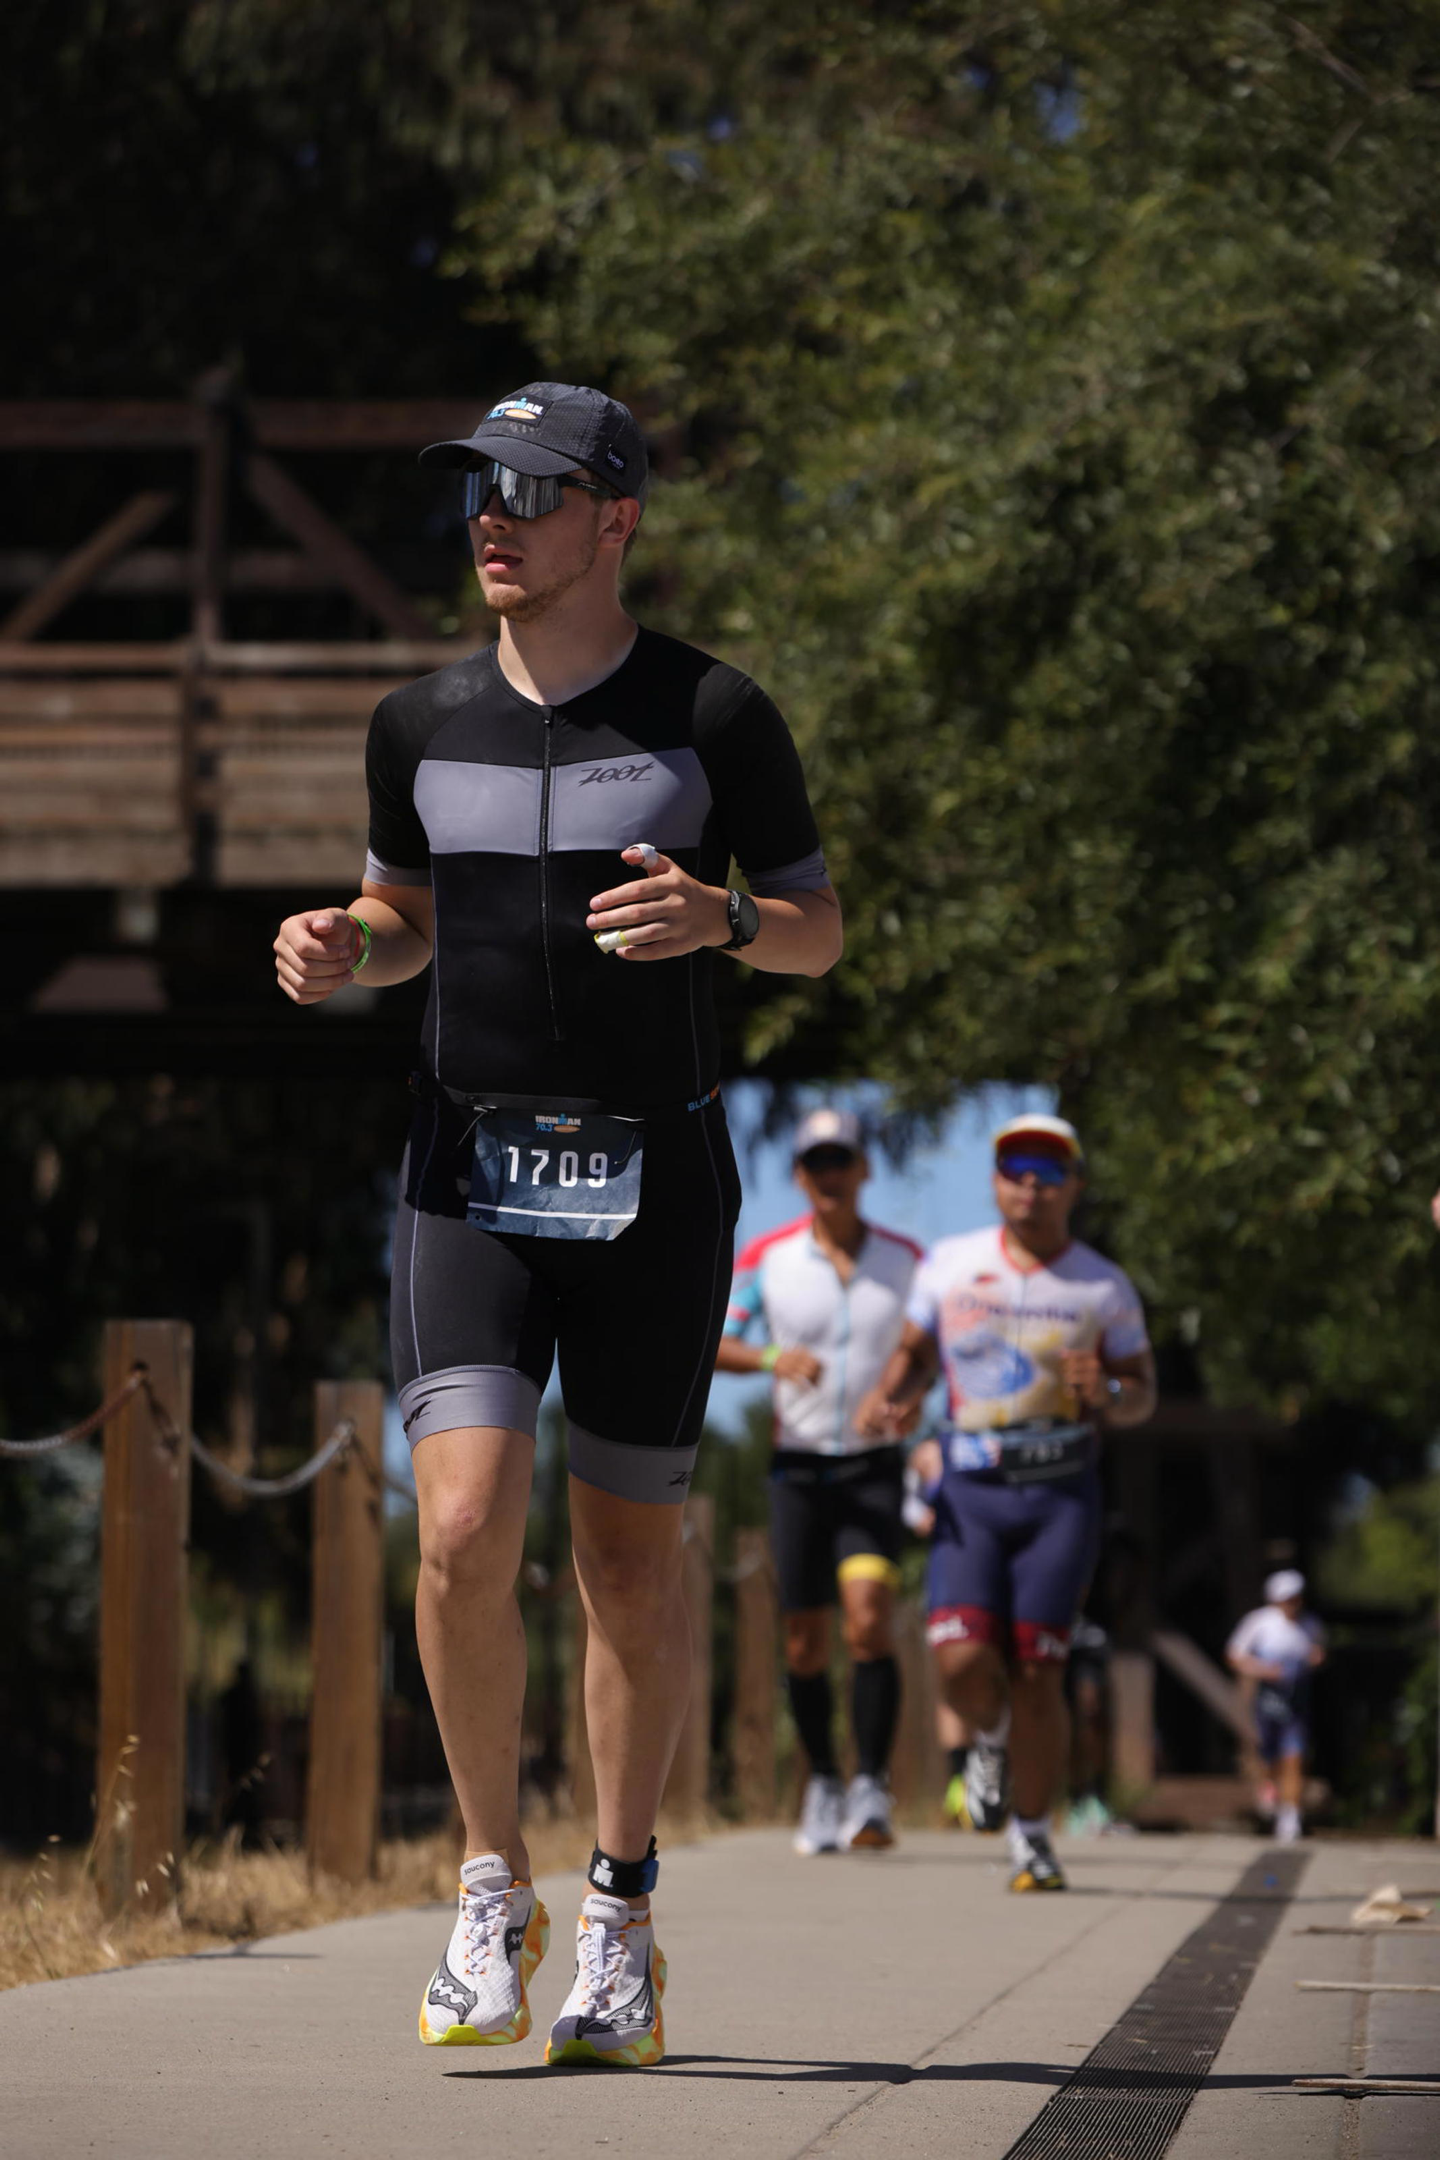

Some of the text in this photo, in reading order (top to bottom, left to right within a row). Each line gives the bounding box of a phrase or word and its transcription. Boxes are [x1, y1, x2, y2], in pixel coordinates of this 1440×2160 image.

[534, 1113, 582, 1126] IRONMAN
[508, 1146, 608, 1188] 1709
[464, 1861, 495, 1876] saucony
[590, 1898, 622, 1912] saucony
